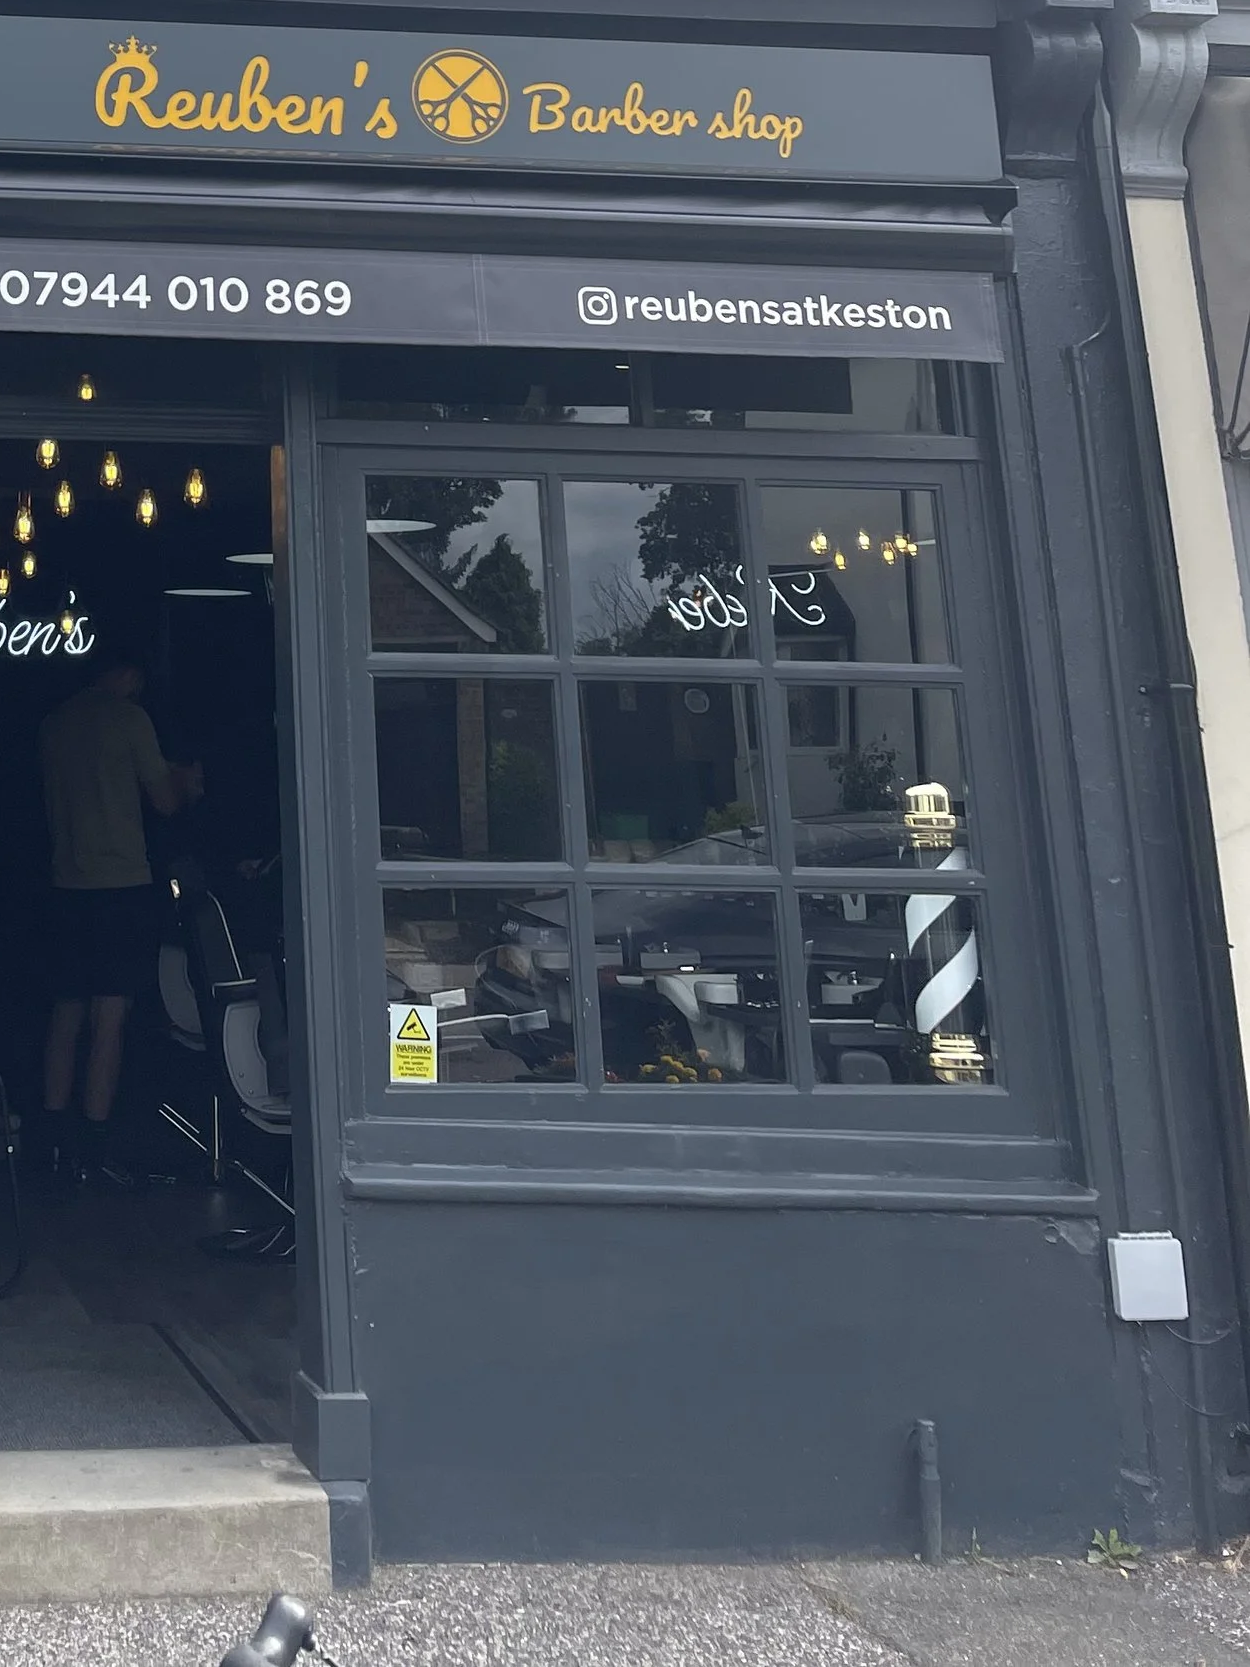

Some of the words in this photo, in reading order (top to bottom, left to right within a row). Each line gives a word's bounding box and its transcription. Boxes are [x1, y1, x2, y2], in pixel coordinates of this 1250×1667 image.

[94, 55, 399, 140] Reuben's
[522, 80, 699, 136] Barber
[707, 87, 804, 159] shop
[167, 275, 249, 314] 010
[264, 278, 352, 317] 869
[624, 290, 953, 331] reubensatkeston
[396, 1044, 432, 1054] WARNING
